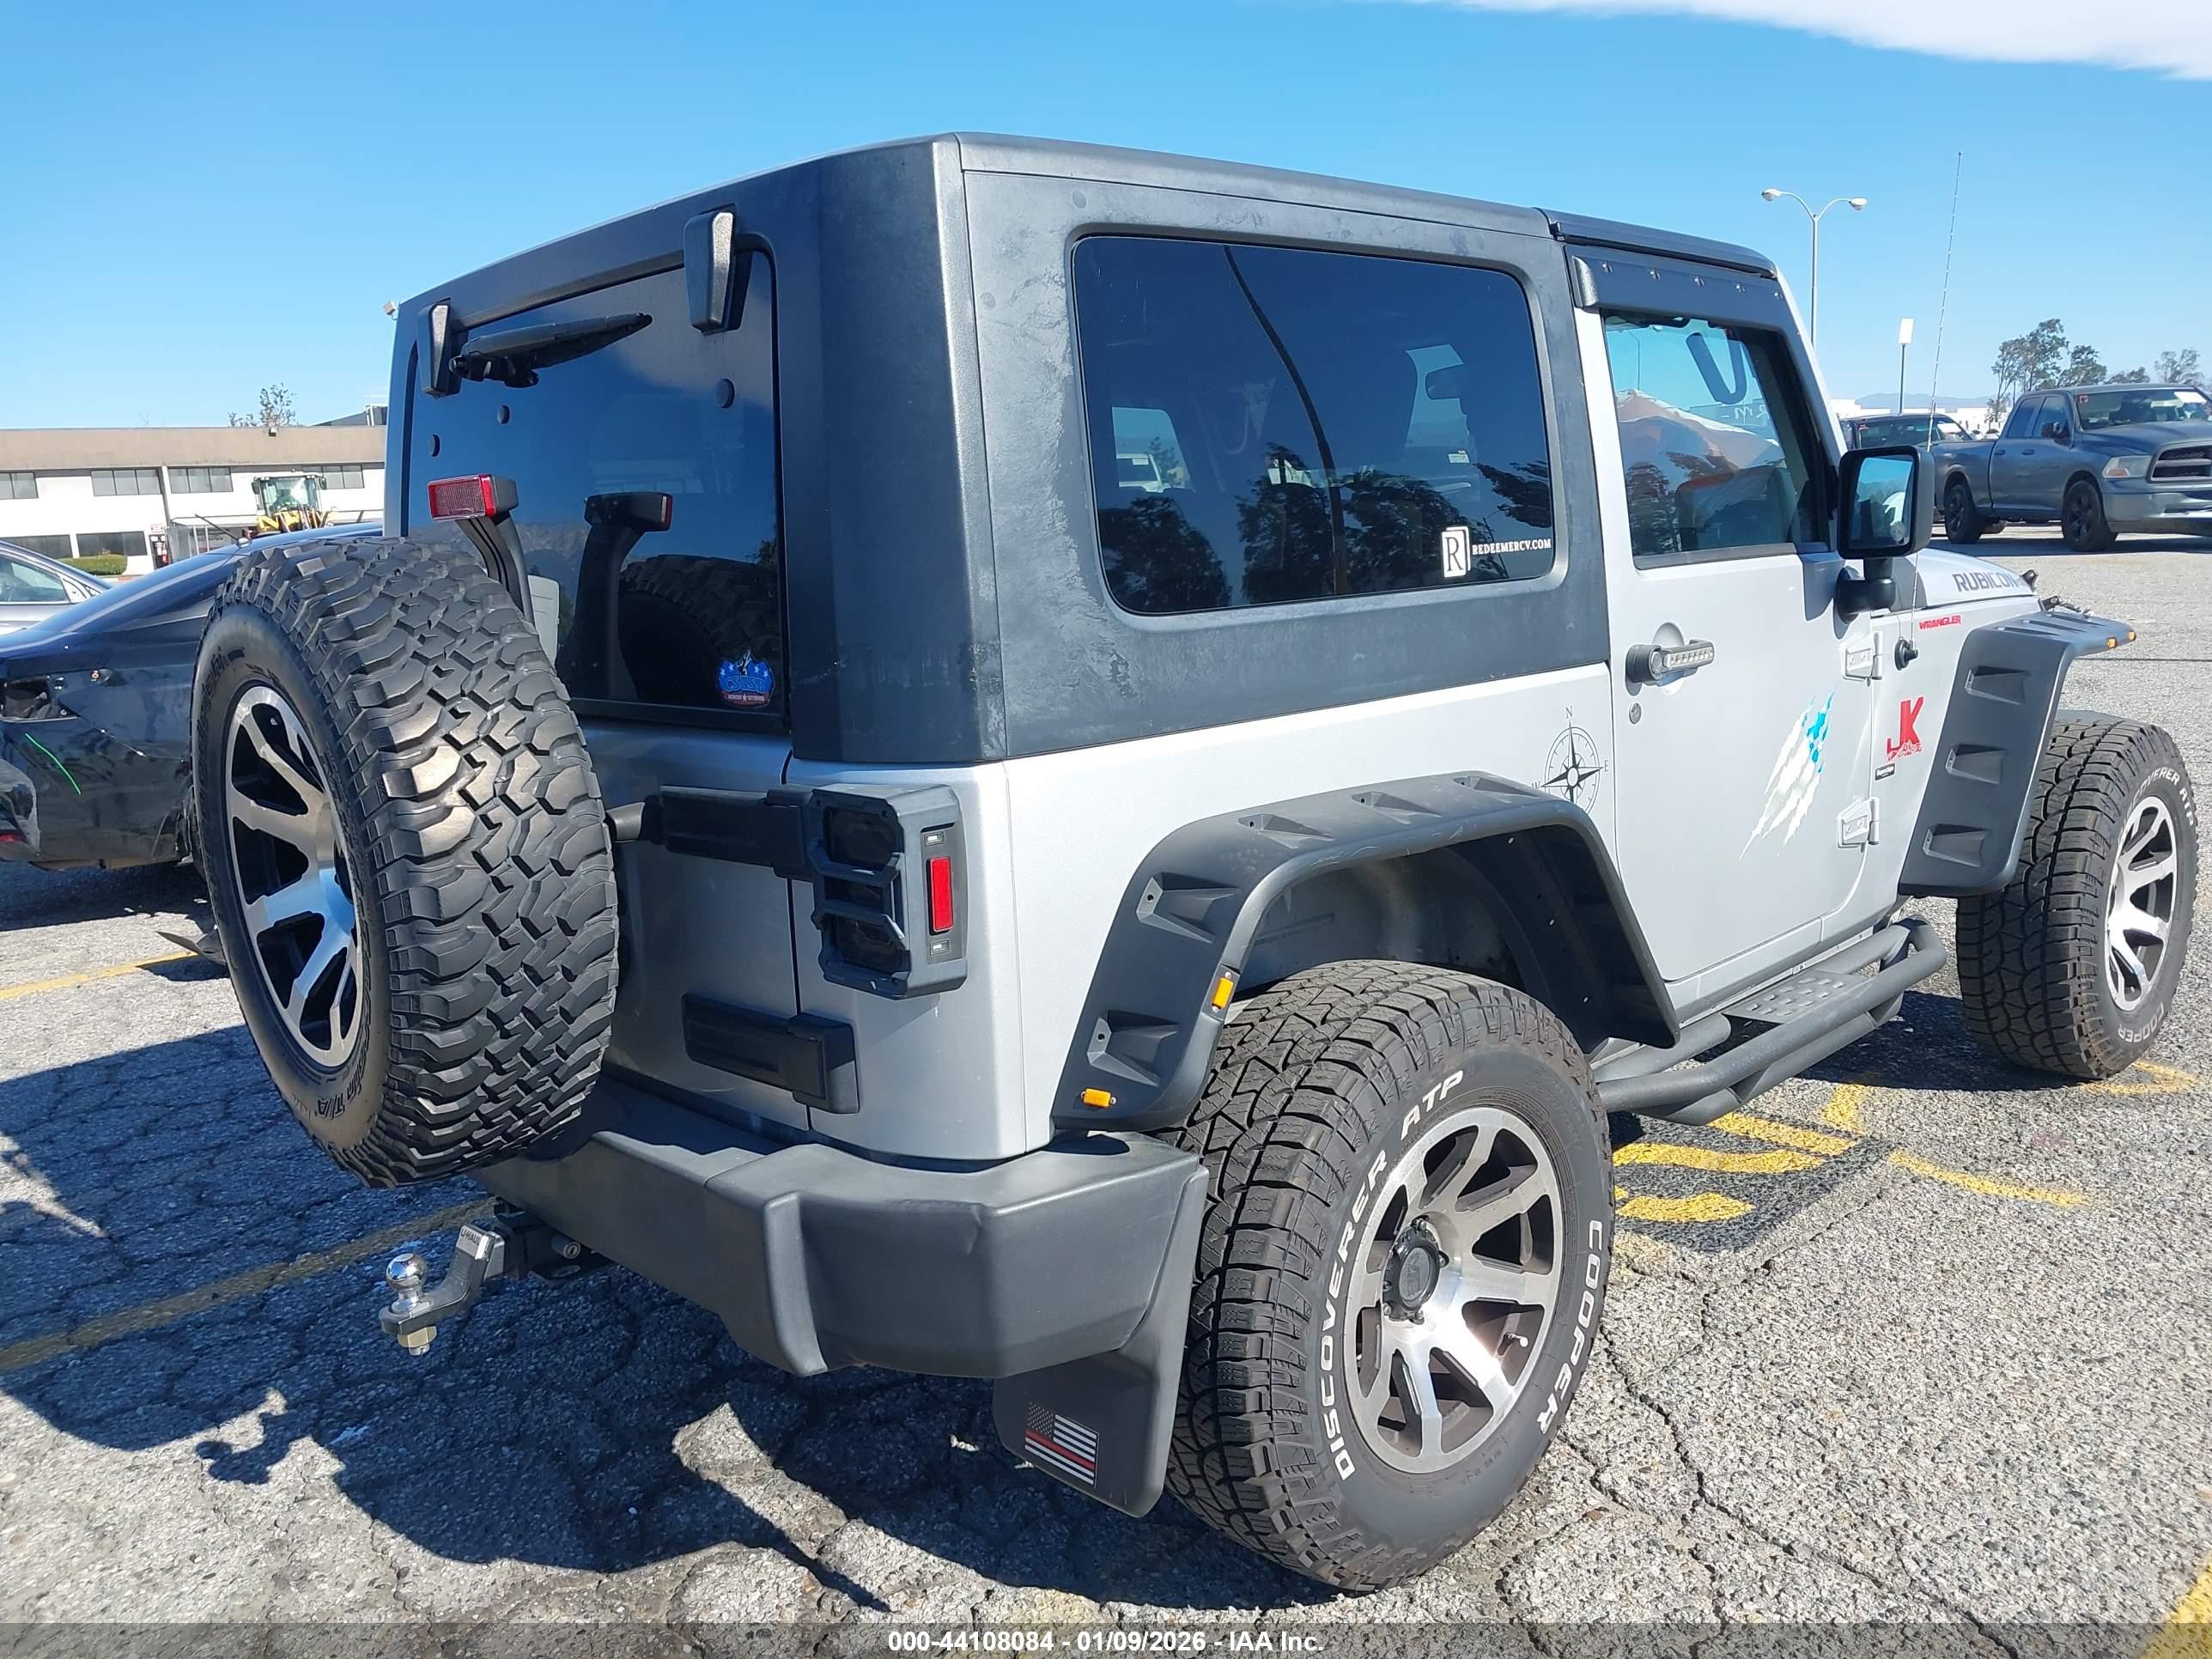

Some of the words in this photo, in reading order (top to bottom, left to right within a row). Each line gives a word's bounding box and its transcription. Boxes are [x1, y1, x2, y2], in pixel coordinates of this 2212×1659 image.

[1444, 537, 1463, 572] R
[1472, 538, 1552, 556] REDEEMERCV.COM
[1952, 573, 2021, 592] RUBICON
[1918, 615, 1962, 629] WRANGLER
[1565, 705, 1573, 719] N
[1887, 696, 1924, 757] JK
[1604, 759, 1609, 772] E
[2179, 787, 2194, 826] ATP
[2118, 1001, 2165, 1043] COOPER
[1319, 1149, 1389, 1481] DISCOVERER
[1400, 1070, 1464, 1141] ATP
[1535, 1219, 1603, 1436] COOPER
